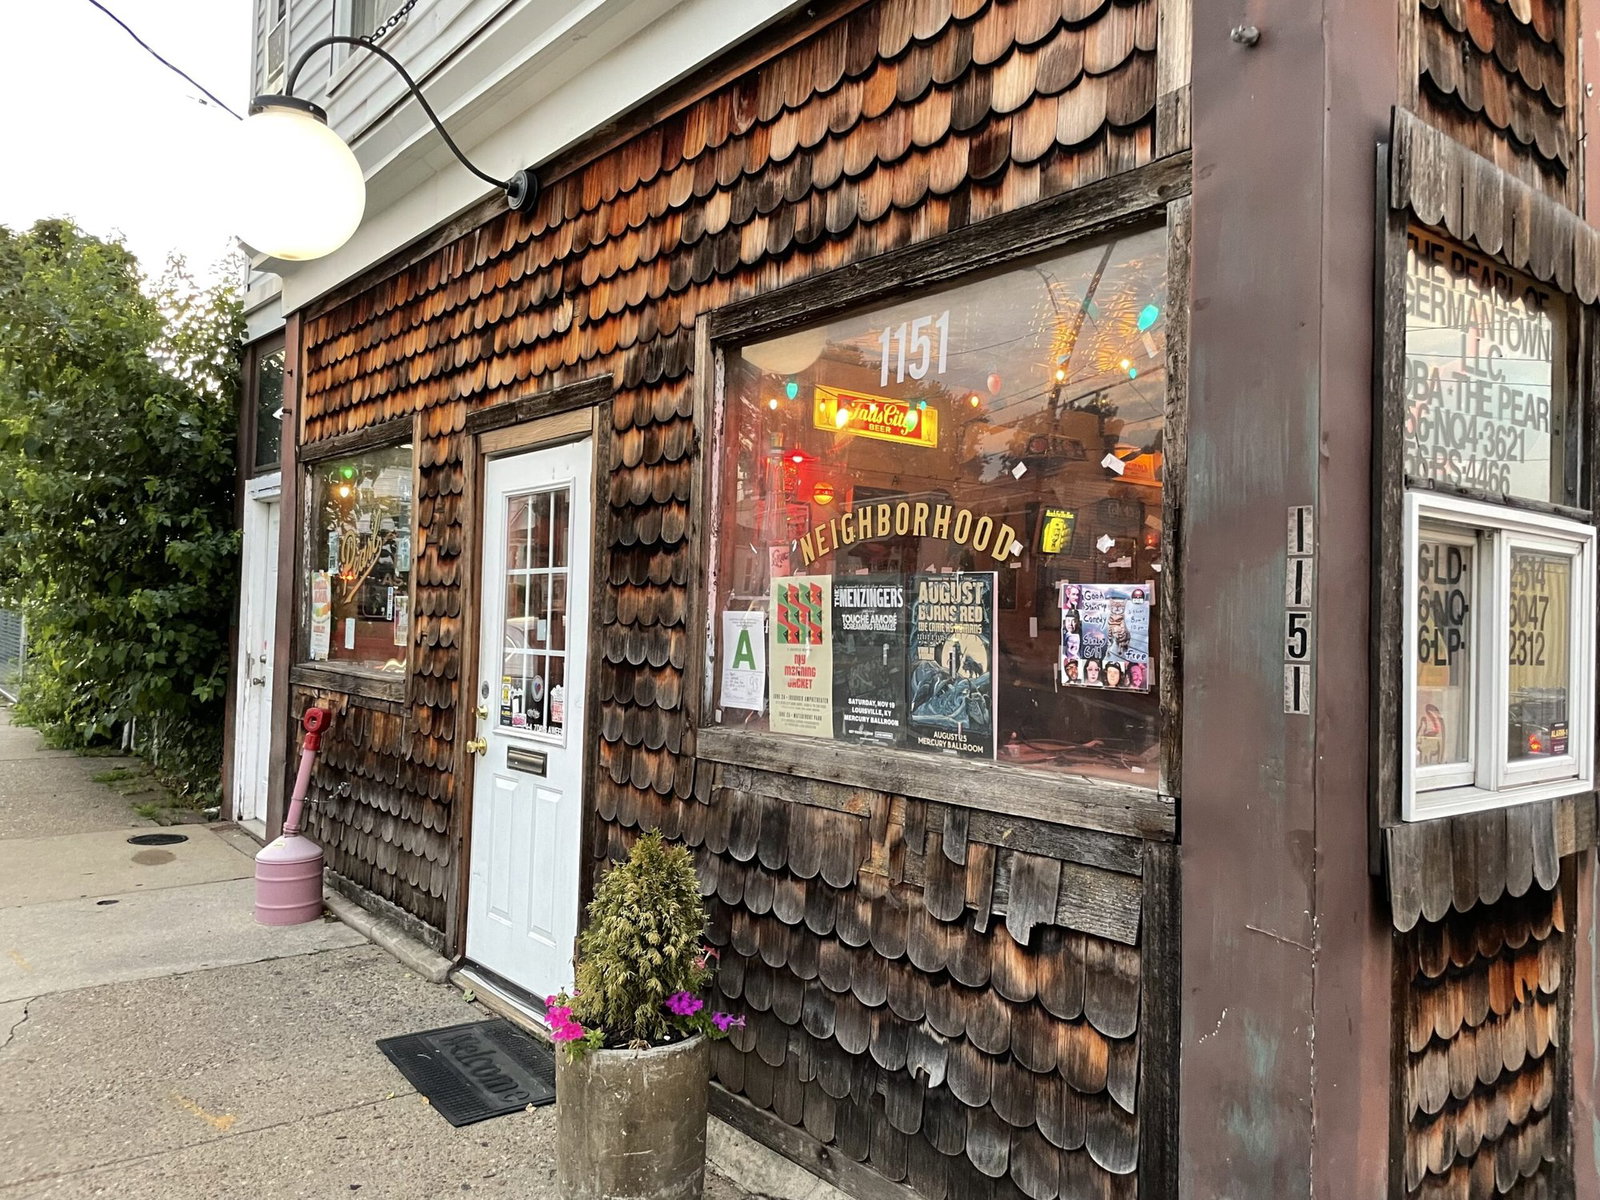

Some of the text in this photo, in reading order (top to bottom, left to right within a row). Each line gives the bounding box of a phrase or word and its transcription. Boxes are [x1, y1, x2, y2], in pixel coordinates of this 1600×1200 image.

[878, 309, 950, 388] 1151
[1451, 370, 1493, 418] THE
[868, 423, 892, 434] BEER
[800, 502, 1016, 567] NEIGHBORHOOD
[840, 588, 904, 608] MENZINGERS
[918, 581, 985, 605] AUGUST
[918, 604, 983, 623] BURNS RED
[731, 629, 757, 671] A
[870, 716, 899, 726] BALLROOM
[918, 737, 946, 748] MERCURY
[947, 741, 984, 753] BALLROOM
[934, 731, 958, 741] AUGUST
